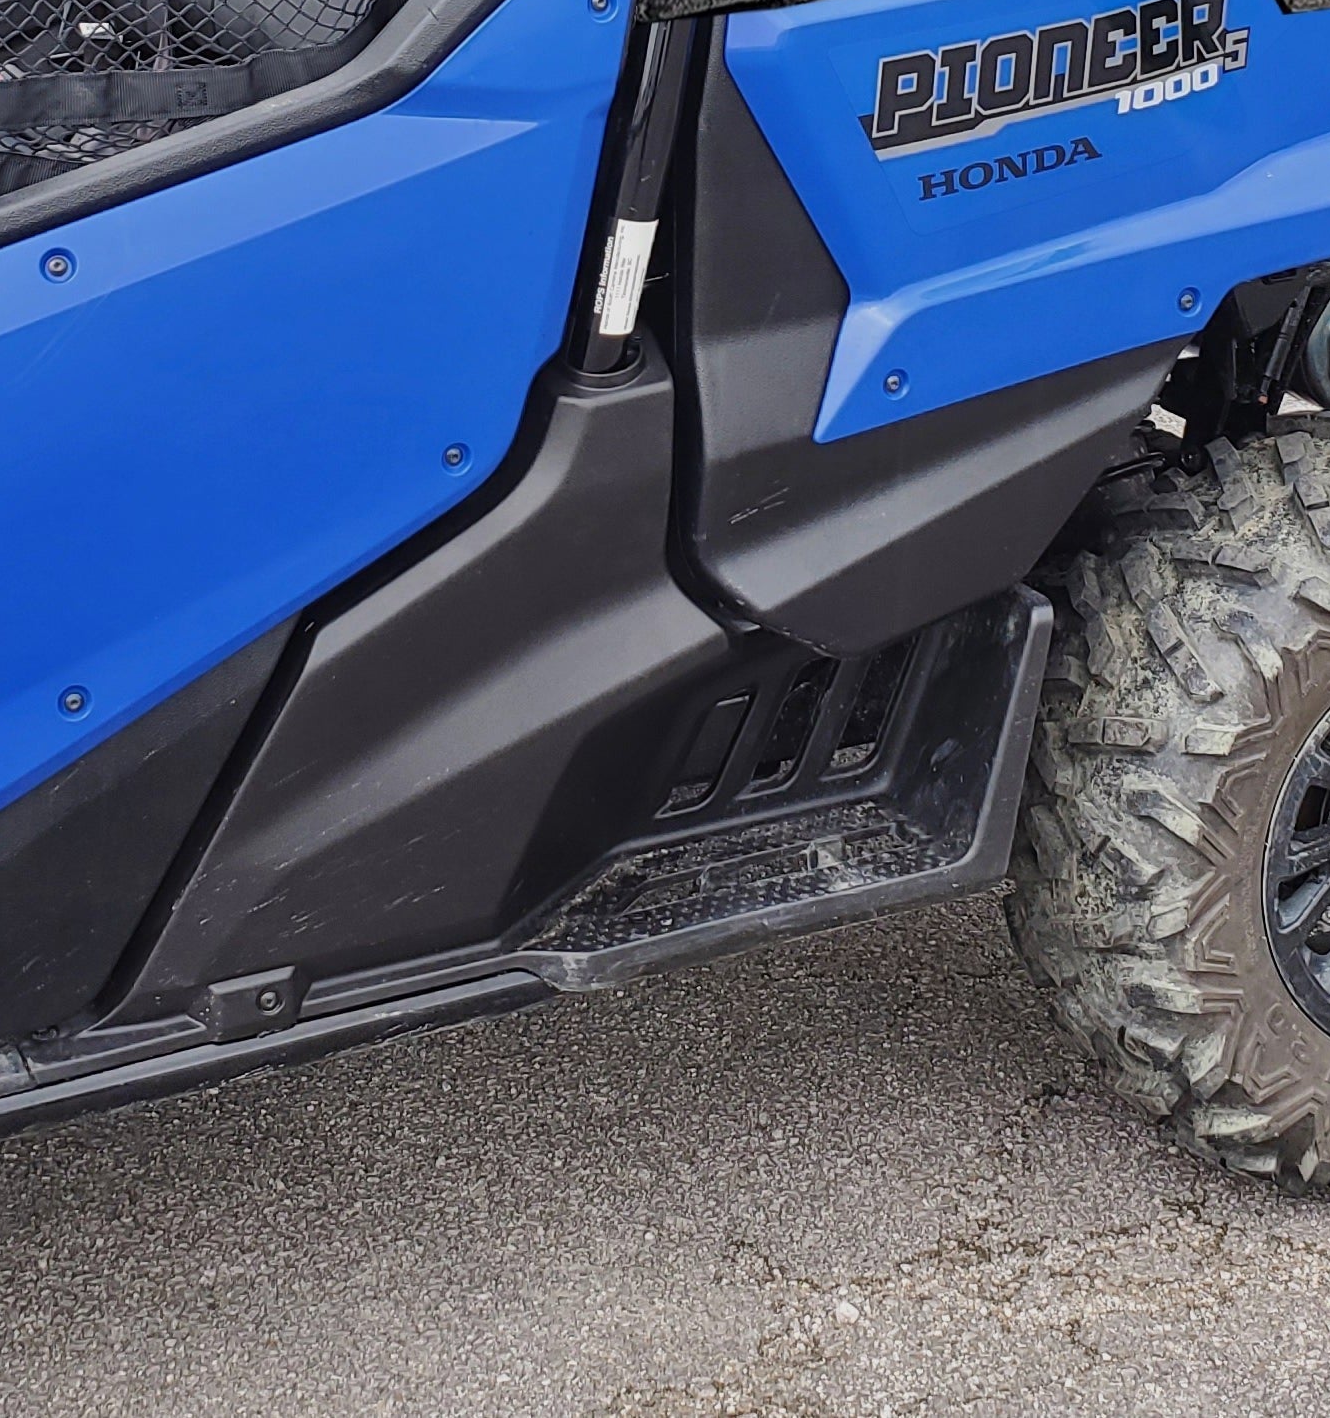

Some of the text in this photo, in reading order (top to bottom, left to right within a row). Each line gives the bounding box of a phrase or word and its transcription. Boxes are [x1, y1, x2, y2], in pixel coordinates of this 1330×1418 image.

[1115, 27, 1251, 114] 1000 5
[918, 137, 1102, 201] HONDA
[599, 236, 615, 286] Information
[594, 287, 606, 314] ROPS
